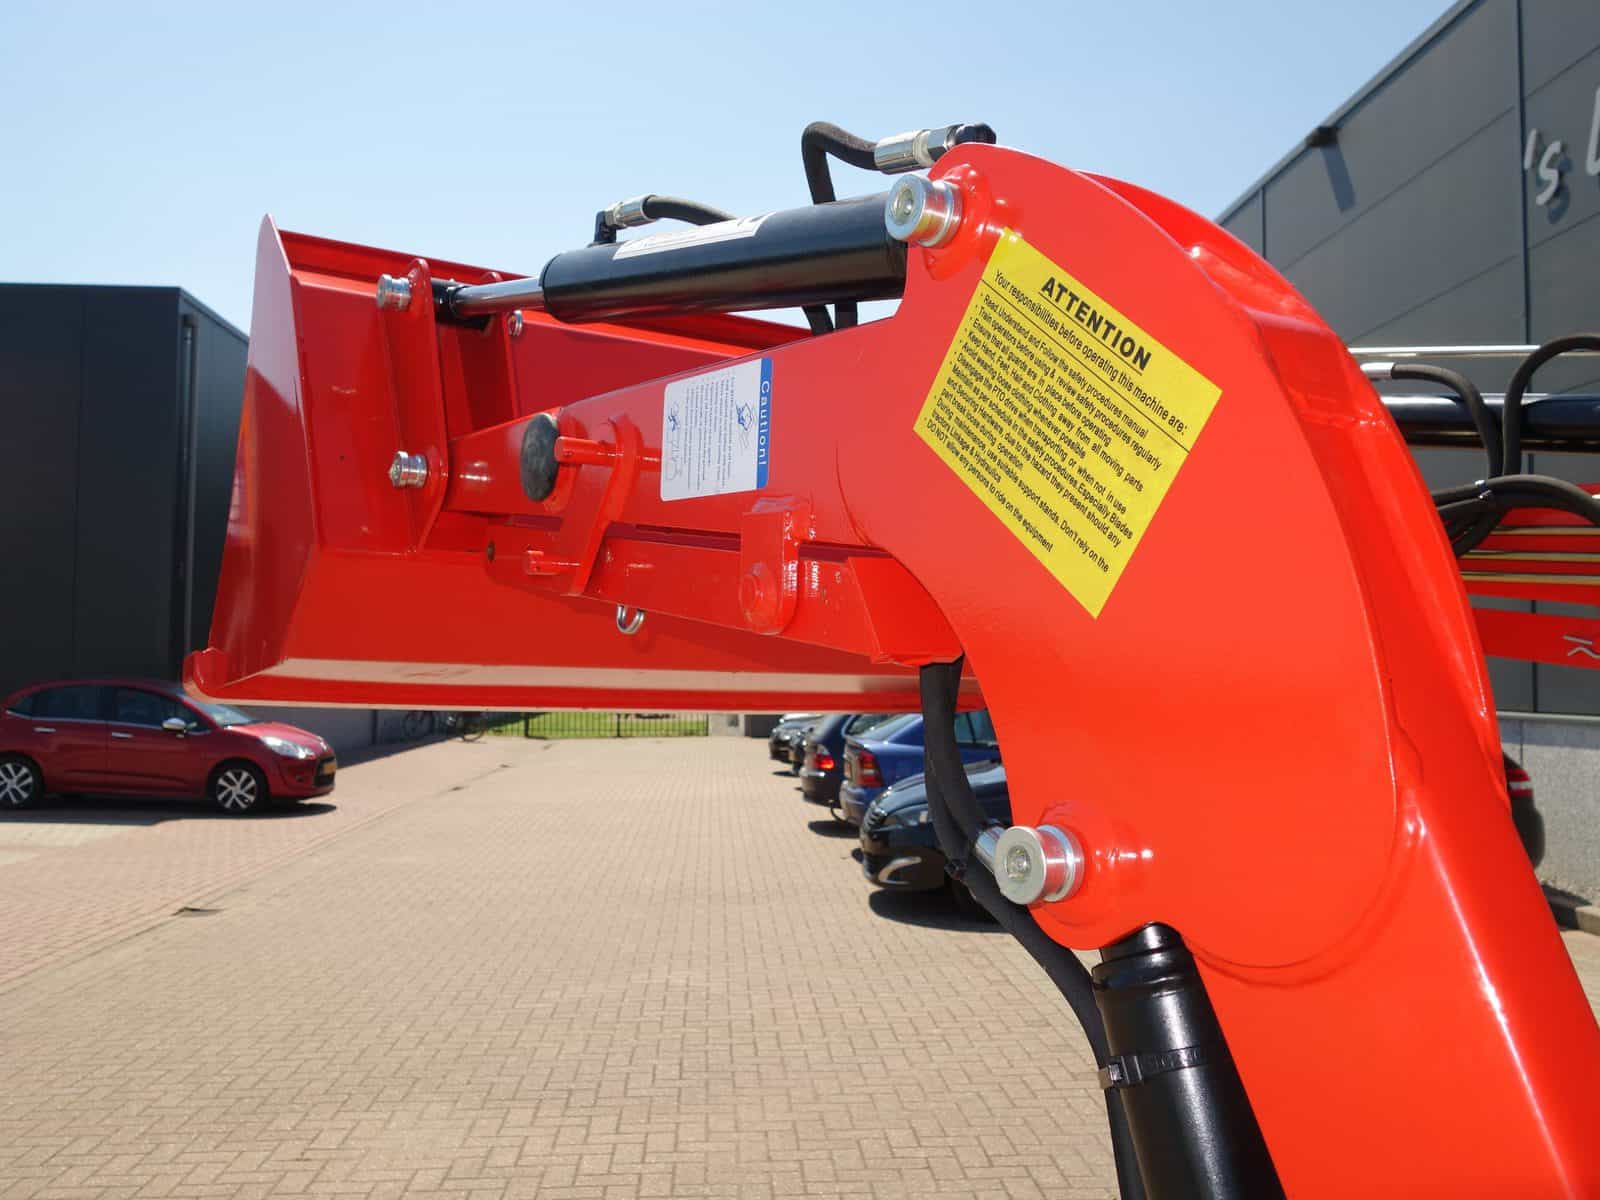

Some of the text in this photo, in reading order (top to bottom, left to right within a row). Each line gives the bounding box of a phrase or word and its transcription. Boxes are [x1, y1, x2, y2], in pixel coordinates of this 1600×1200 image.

[994, 269, 1187, 435] Your responsibilities before operating this machine are:
[1040, 276, 1152, 371] ATTENTION
[758, 380, 771, 465] Caution!
